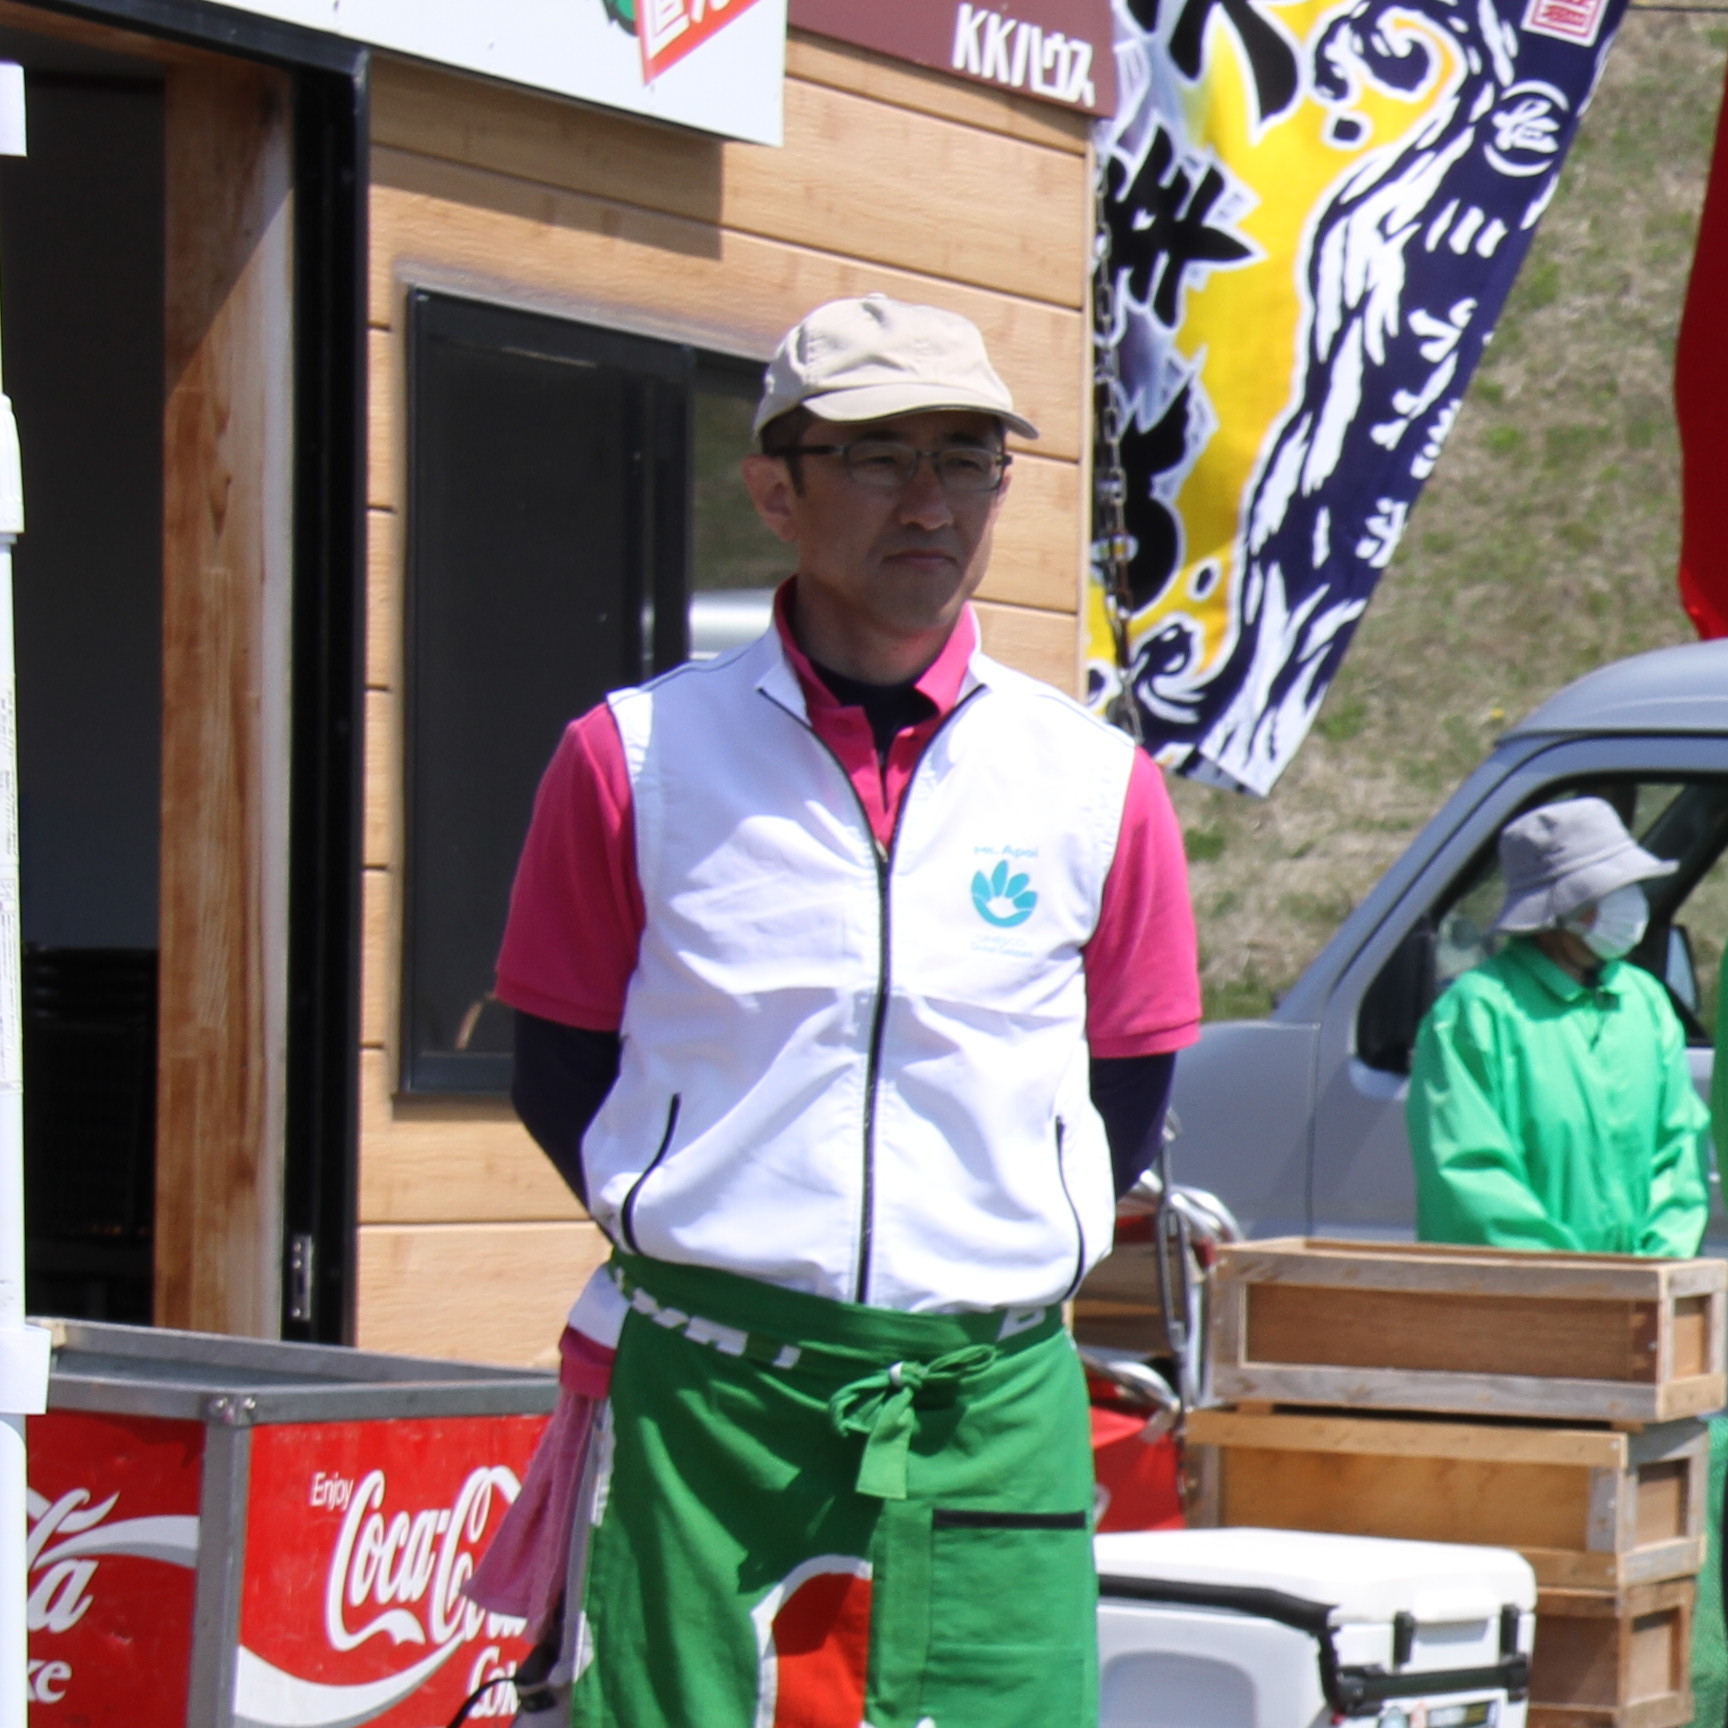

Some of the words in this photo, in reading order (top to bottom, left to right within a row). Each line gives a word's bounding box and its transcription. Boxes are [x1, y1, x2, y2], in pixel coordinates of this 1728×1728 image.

[310, 1471, 354, 1512] Enjoy
[326, 1466, 528, 1652] Coca-Co
[467, 1645, 521, 1720] Cok
